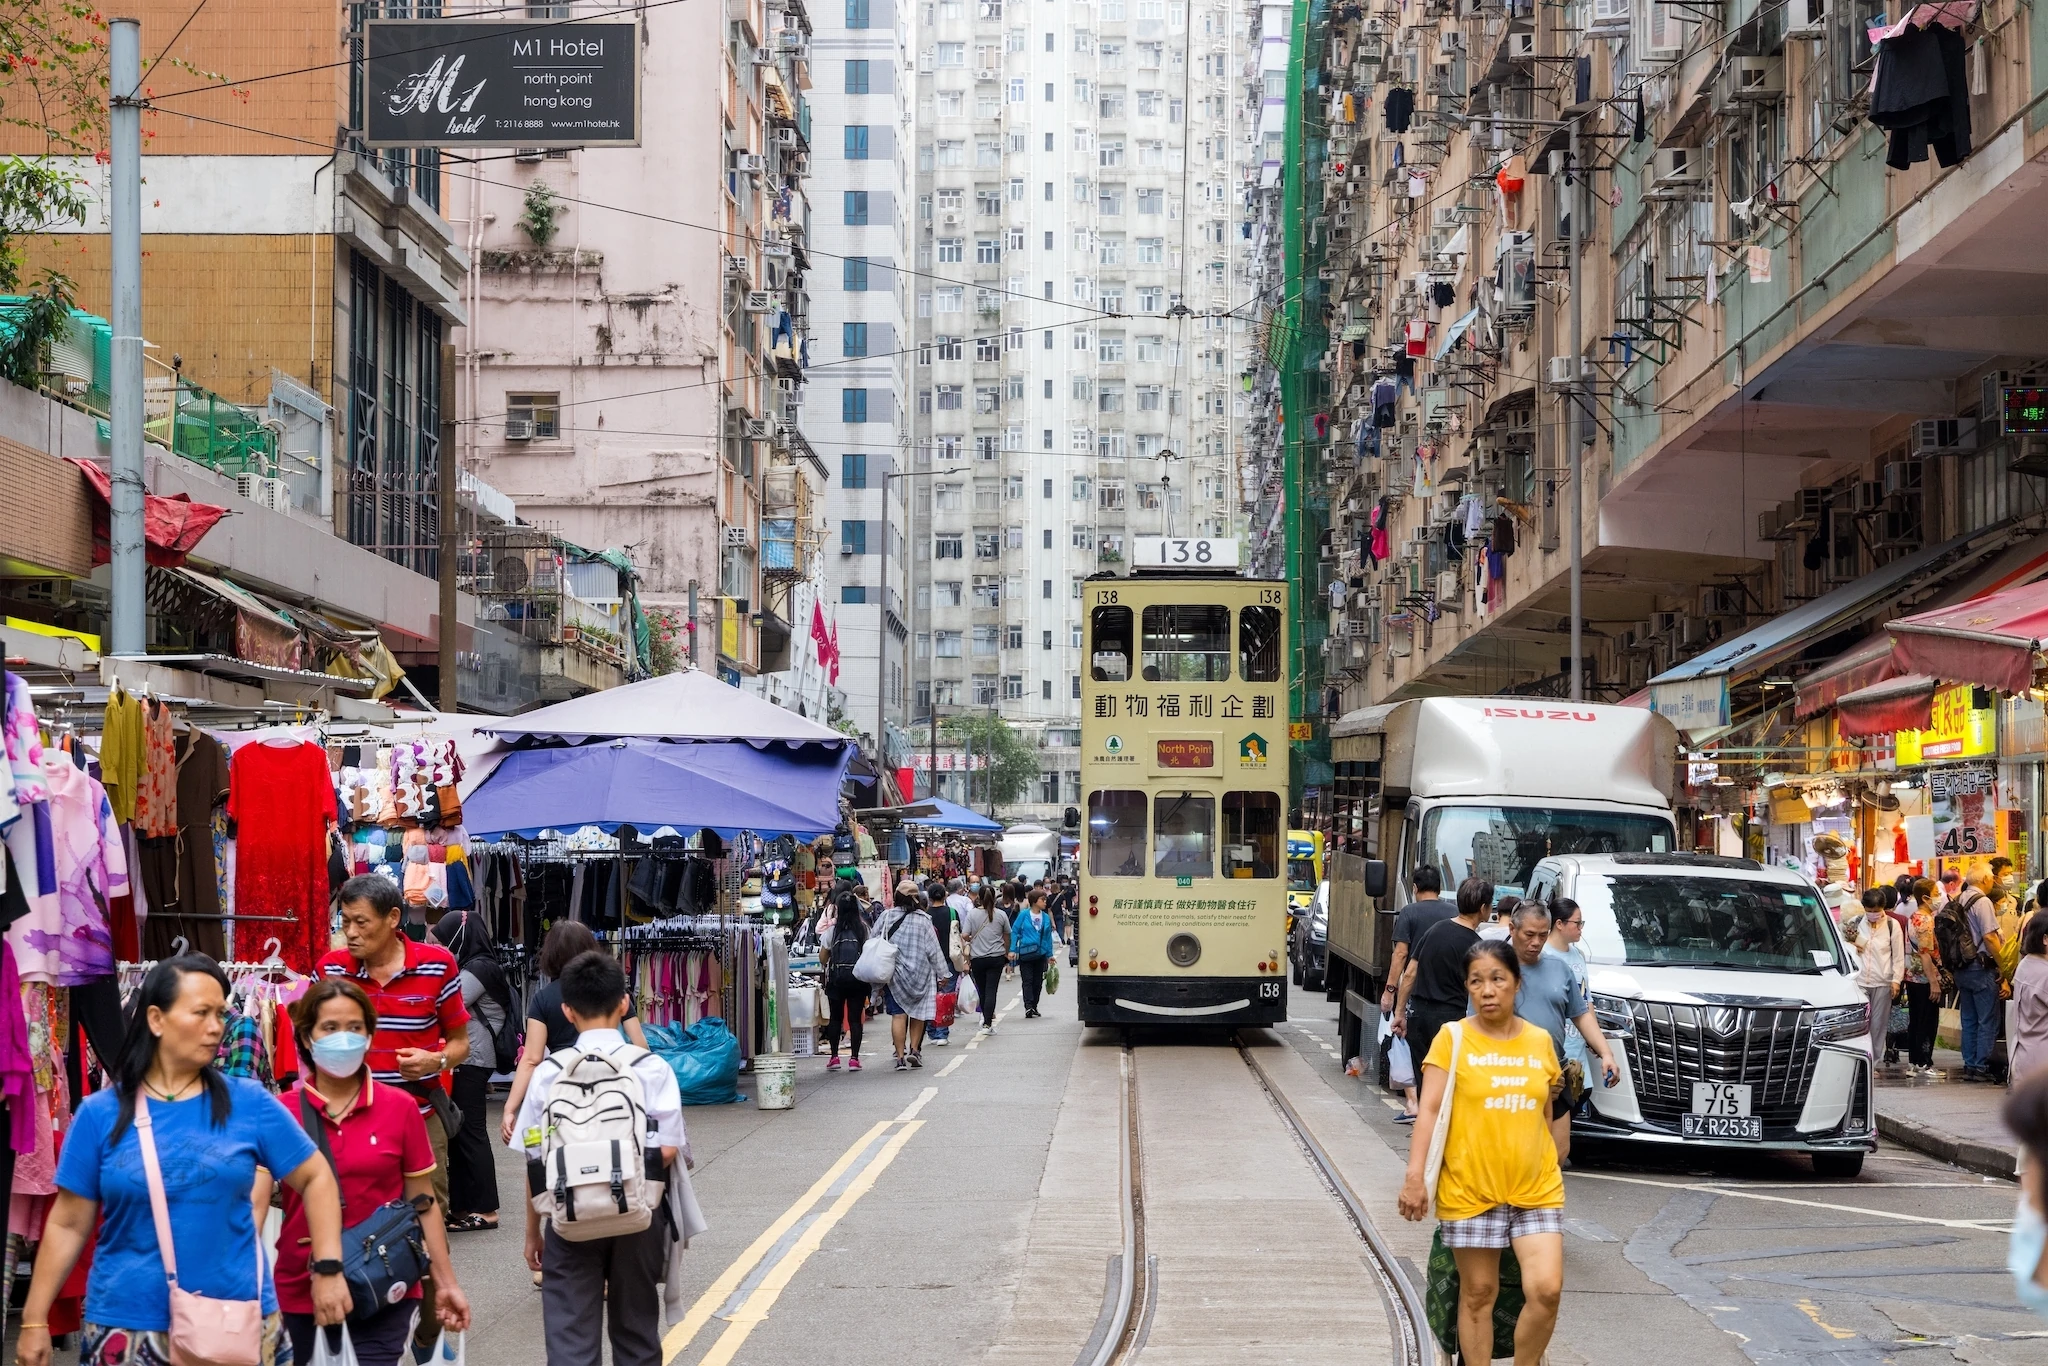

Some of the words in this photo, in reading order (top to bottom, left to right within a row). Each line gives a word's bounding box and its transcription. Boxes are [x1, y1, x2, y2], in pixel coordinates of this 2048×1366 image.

[513, 39, 541, 56] M1
[551, 38, 604, 56] Hotel
[524, 73, 556, 84] north
[560, 73, 592, 87] point
[524, 96, 556, 108] hong
[560, 96, 592, 108] kong
[445, 115, 486, 134] hotel
[504, 120, 523, 128] 2116
[524, 120, 543, 128] 8888
[551, 120, 620, 128] www.m1hotel.hk
[1161, 541, 1212, 563] 138
[1097, 591, 1118, 604] 138
[1260, 590, 1281, 604] 138
[1095, 694, 1274, 718] 動物福利企劃
[1484, 707, 1596, 722] ISUZU
[1158, 744, 1185, 753] North
[1189, 744, 1213, 753] Point
[1171, 756, 1201, 765] 北角
[1931, 771, 1992, 797] 雪花肥牛
[1113, 899, 1173, 910] 履行謹慎責任
[1176, 899, 1256, 910] 做好動物醫食住行
[1259, 983, 1279, 998] 138
[1467, 1053, 1525, 1067] believe
[1528, 1054, 1542, 1069] in
[1490, 1076, 1528, 1088] your
[1711, 1084, 1734, 1100] YG
[1484, 1093, 1537, 1114] selfie
[1705, 1099, 1738, 1115] 715
